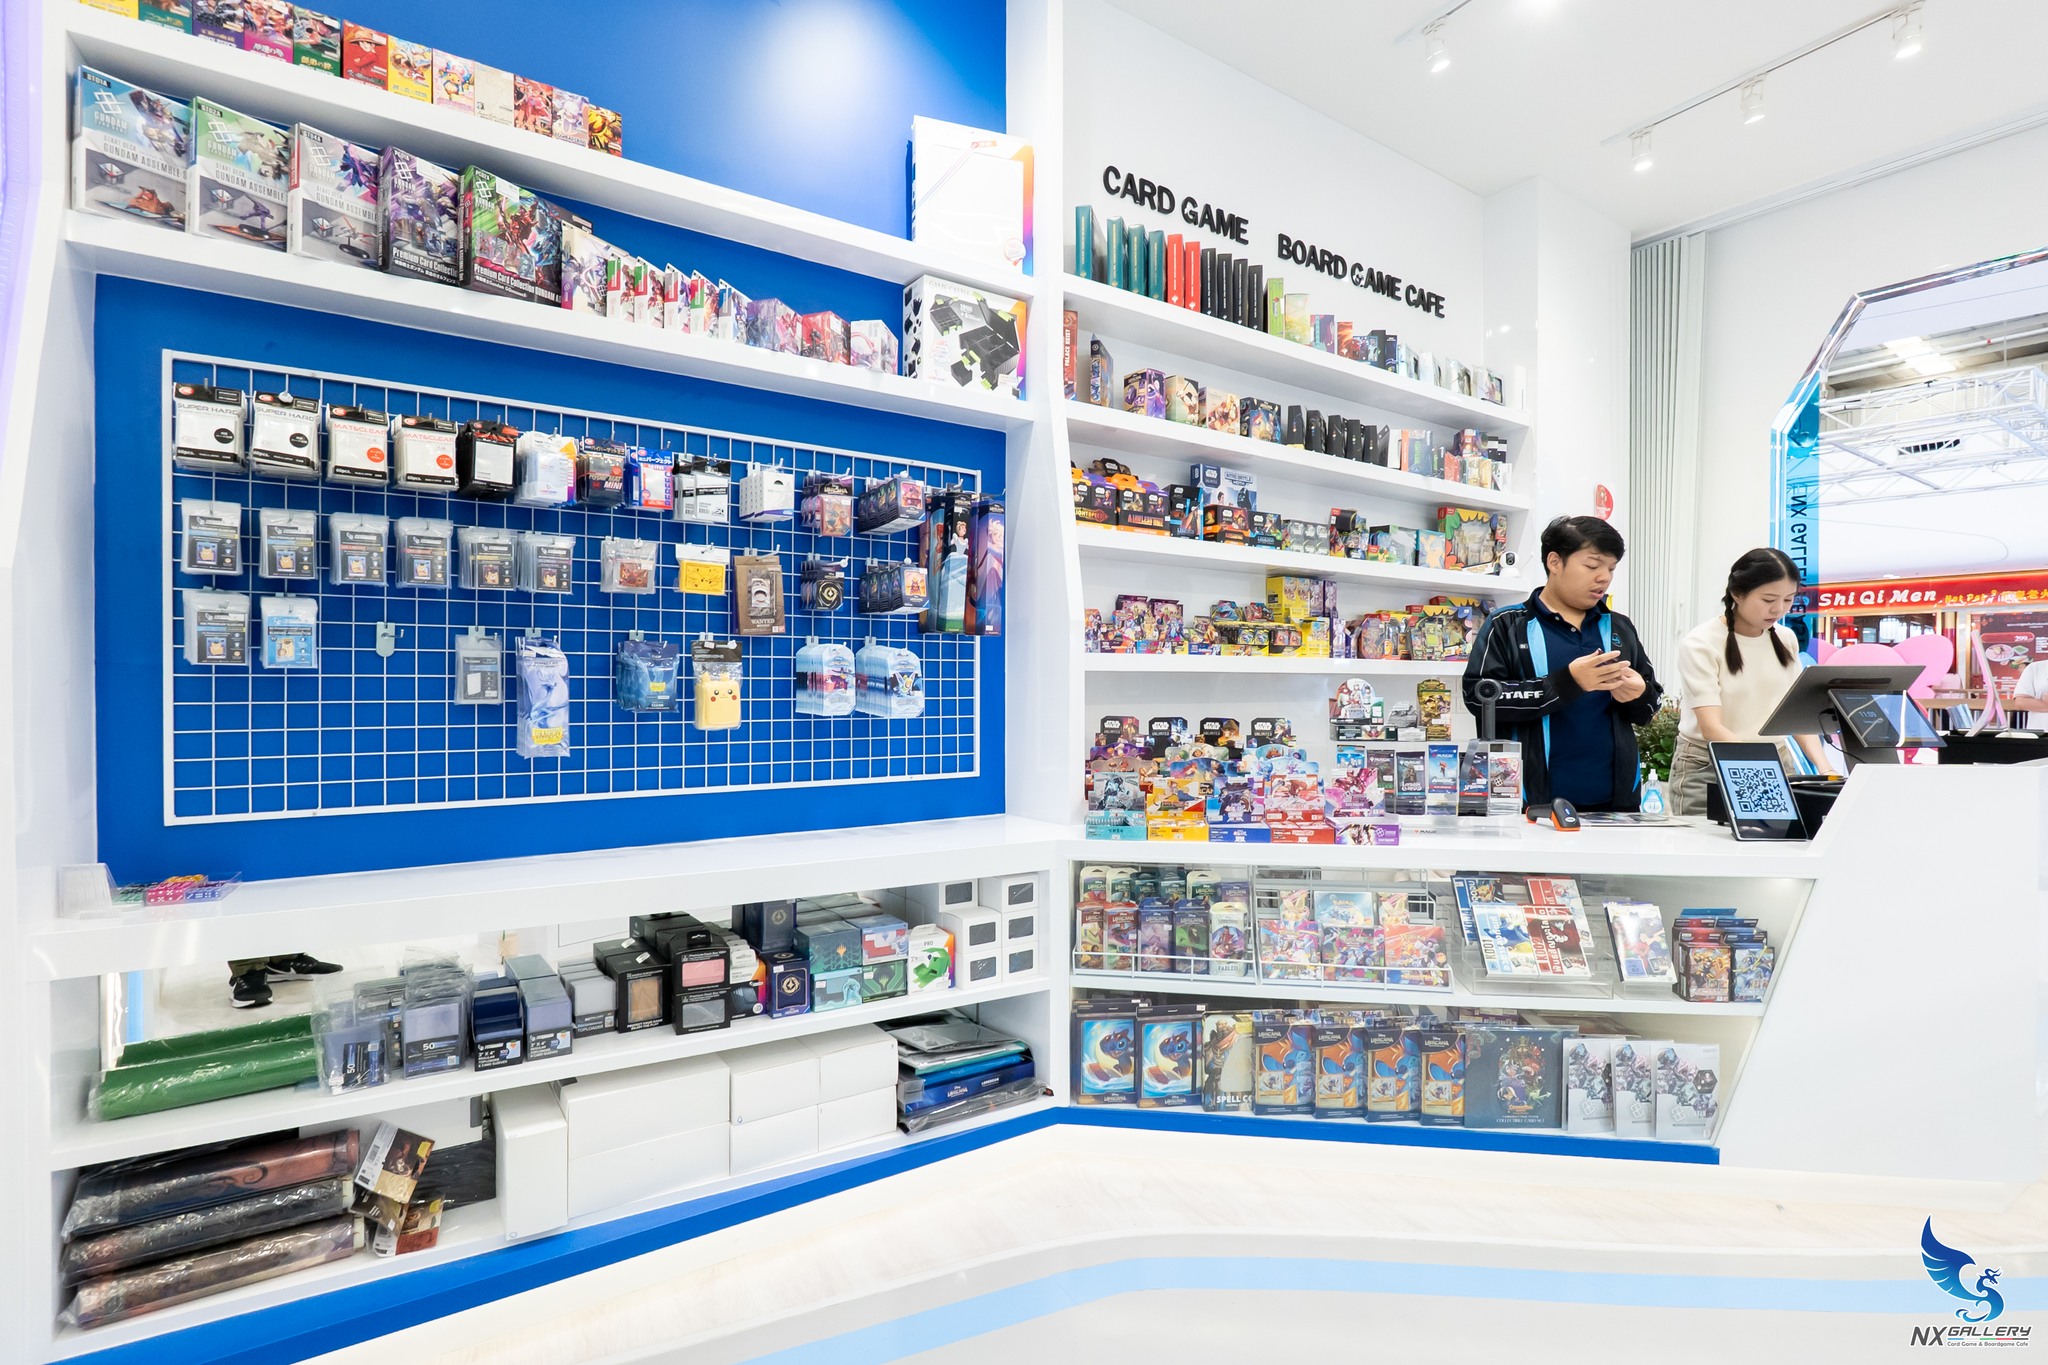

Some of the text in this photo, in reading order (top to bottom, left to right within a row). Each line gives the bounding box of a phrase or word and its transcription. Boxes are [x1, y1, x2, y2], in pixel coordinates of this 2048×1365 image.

[95, 112, 128, 130] GUNDAM
[208, 139, 236, 157] GUNDAM
[104, 143, 139, 162] GUNDAM
[141, 154, 182, 178] ASSEMBLE
[216, 170, 284, 201] GUNDAM ASSEMBLE
[316, 193, 378, 222] GUNDAM ASSEMBLE
[1103, 165, 1249, 246] CARD GAME
[393, 247, 433, 269] Premium Card
[474, 263, 497, 281] Premium
[497, 273, 510, 285] Card
[510, 277, 535, 294] Collection
[1278, 233, 1445, 319] BOARD GAME CAFE
[177, 402, 240, 415] SUPER HARD
[256, 406, 315, 422] SUPER HARD
[334, 423, 386, 436] MAT&CLEAR
[604, 481, 623, 490] MINI
[1818, 589, 1937, 606] Shi Qi Men
[1945, 594, 1964, 602] Hot
[1500, 689, 1544, 701] STAFF
[577, 1024, 603, 1033] TOPLOADER
[1258, 1031, 1281, 1039] LORCANA
[1318, 1033, 1342, 1041] LORCANA
[1425, 1039, 1449, 1047] LORCANA
[423, 1042, 435, 1051] 50
[347, 1064, 355, 1074] 50
[947, 1087, 968, 1097] LORCANA
[1217, 1095, 1241, 1104] SPELL
